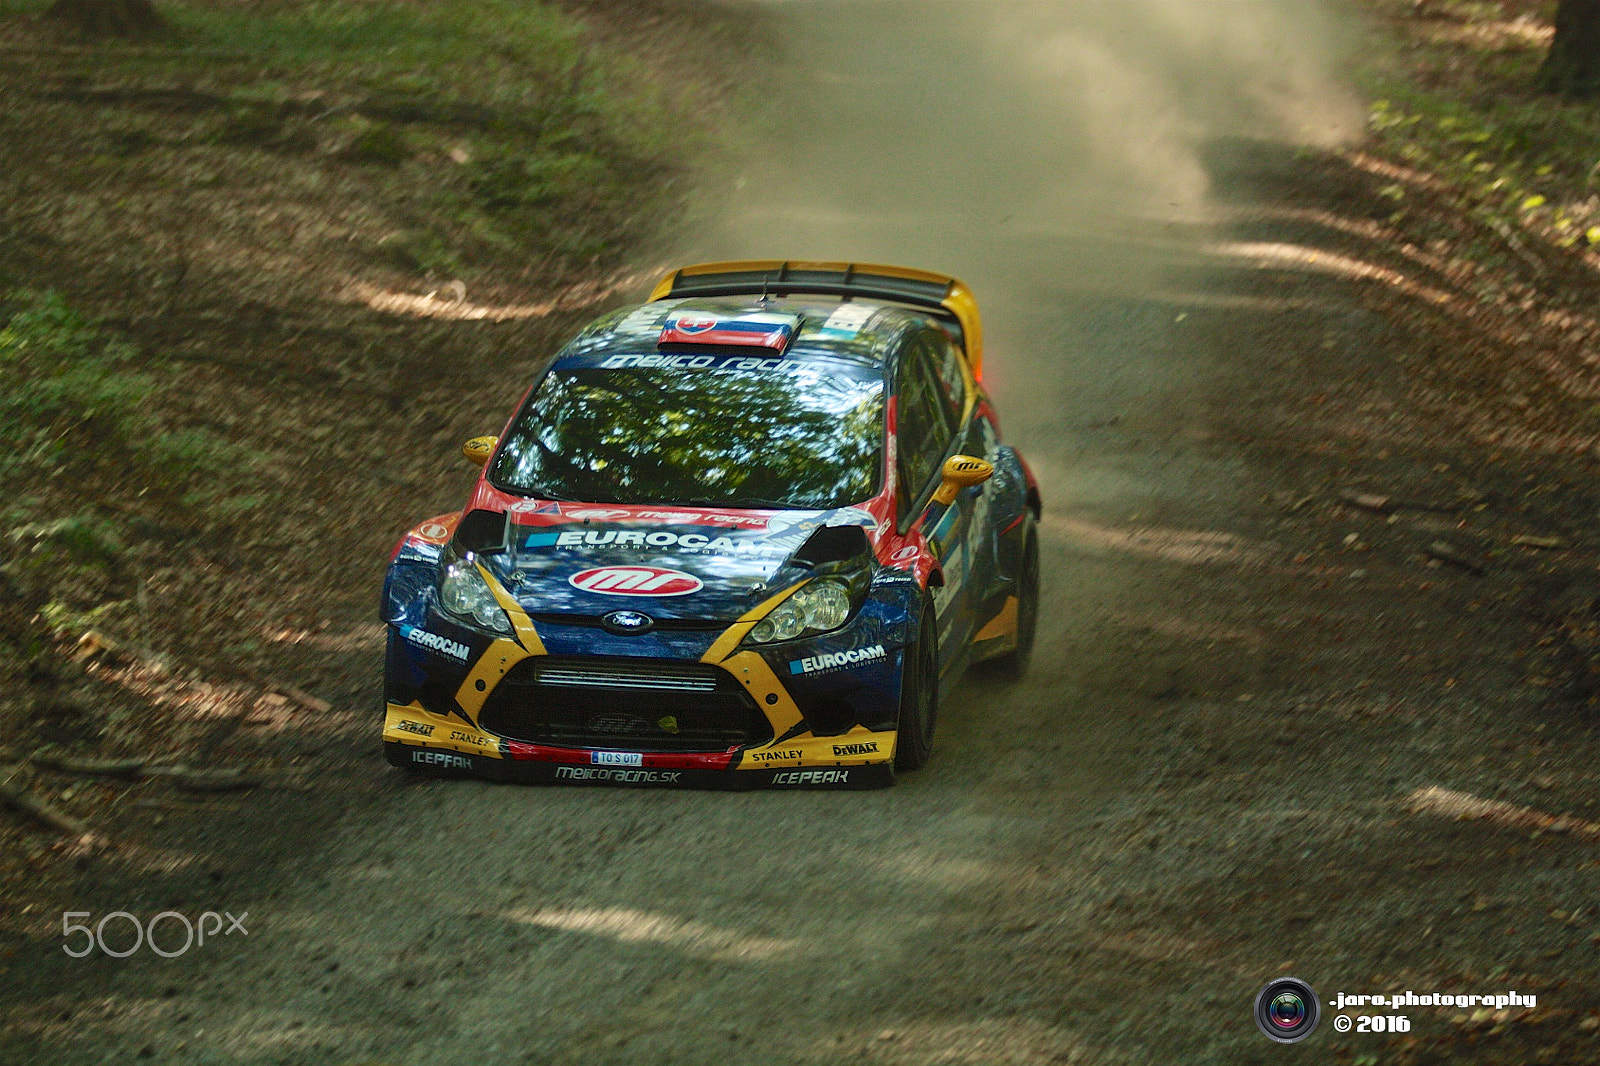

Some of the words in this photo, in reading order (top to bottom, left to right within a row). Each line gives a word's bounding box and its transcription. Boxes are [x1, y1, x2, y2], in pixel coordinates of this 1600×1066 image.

[557, 531, 774, 558] EUROCAM
[408, 628, 470, 662] EUROCAM
[801, 645, 887, 673] EUROCAM
[449, 731, 490, 746] STANLEY
[602, 753, 613, 763] TO
[615, 754, 621, 763] S
[623, 755, 639, 764] 017
[752, 751, 803, 761] STANLEY
[771, 771, 848, 784] ICEPEAK
